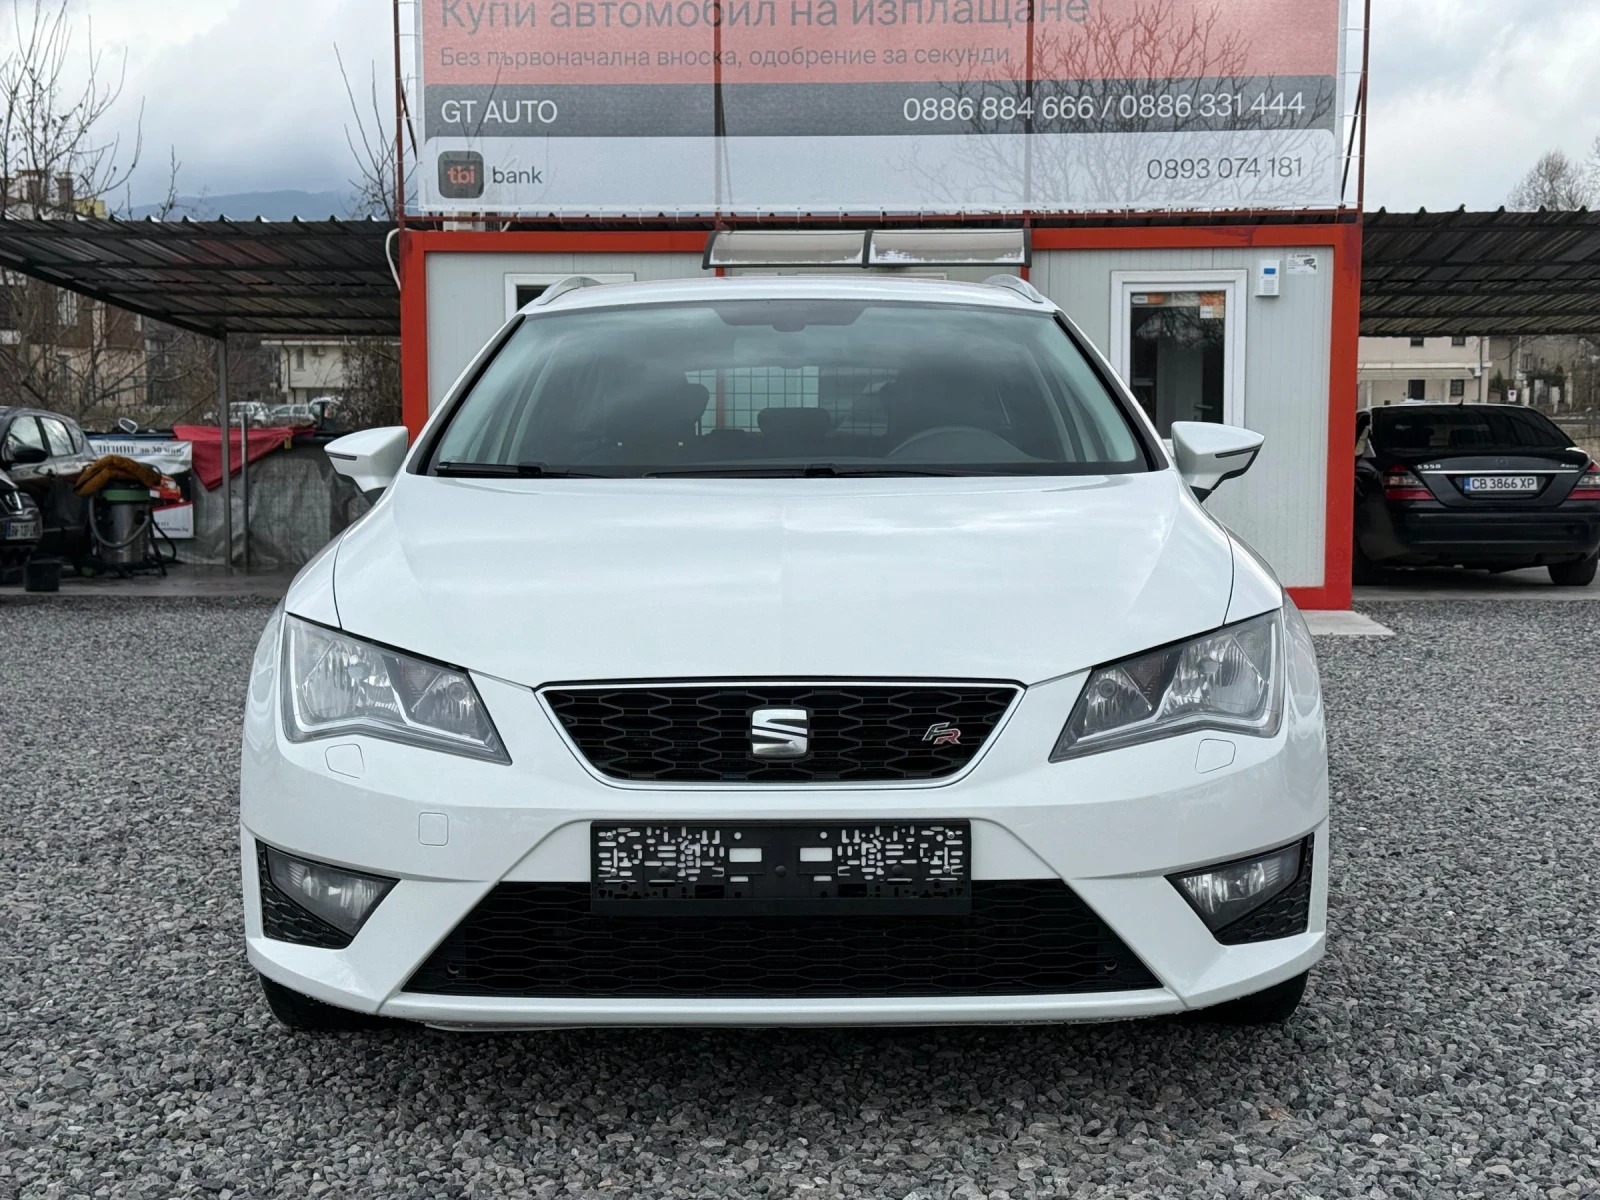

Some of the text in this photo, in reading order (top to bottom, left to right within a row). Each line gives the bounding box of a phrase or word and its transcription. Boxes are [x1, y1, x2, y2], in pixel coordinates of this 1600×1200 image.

[442, 0, 1089, 35] Купи автомобил на изплащане
[440, 46, 1009, 71] Без първоначална вноска, одобрение за секунди
[441, 100, 558, 123] GT AUTO
[903, 92, 1306, 121] 0886 884 666 / 0886 331 444
[447, 165, 543, 184] tbi bank
[1147, 157, 1302, 180] 0893 074 181
[1471, 478, 1535, 490] CB 3866 XP
[921, 721, 962, 745] FR
